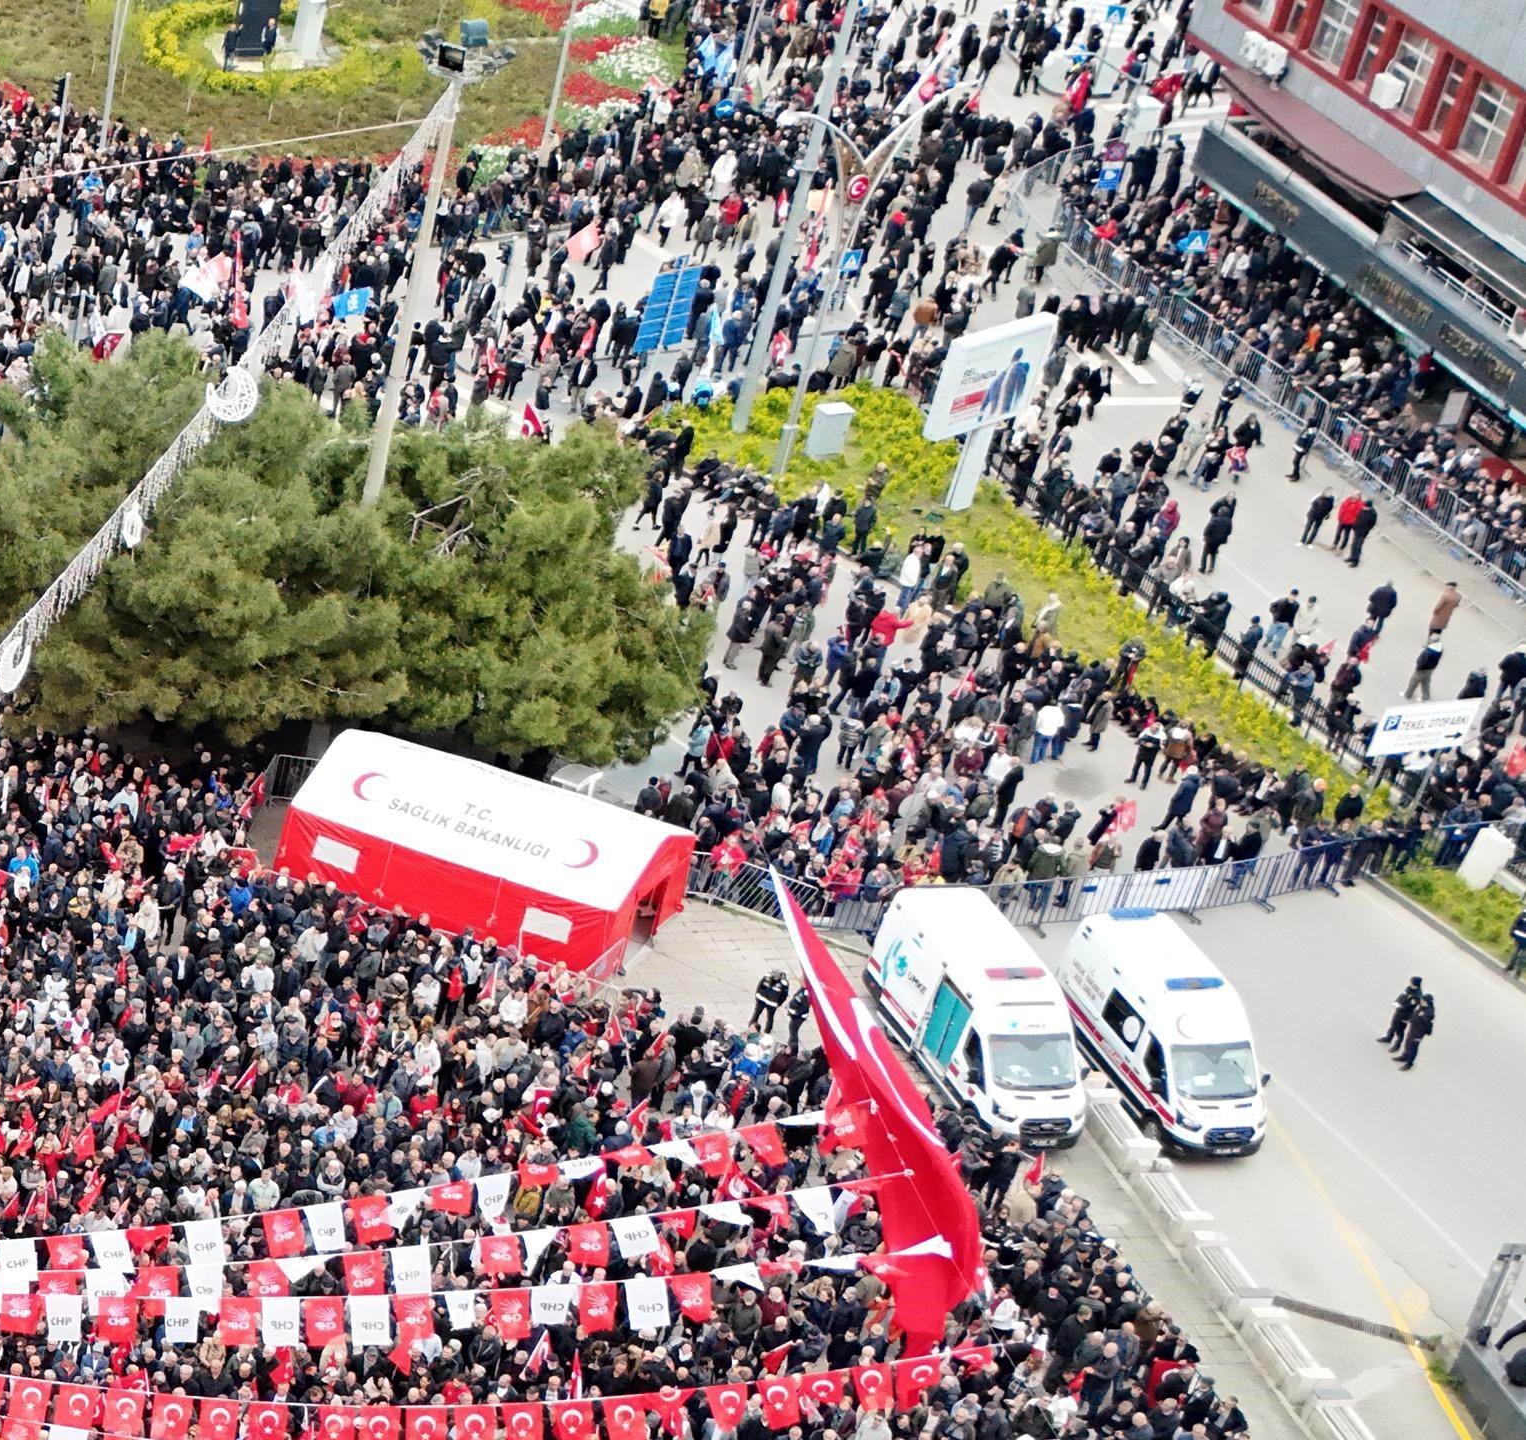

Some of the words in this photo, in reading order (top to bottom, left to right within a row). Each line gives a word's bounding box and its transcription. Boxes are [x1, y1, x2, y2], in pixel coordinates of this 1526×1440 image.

[463, 802, 493, 821] T.C.
[387, 797, 451, 829] SAĞLIK
[453, 820, 550, 861] BAKANLIĞI
[834, 1123, 856, 1136] CHP
[442, 1191, 463, 1200] CHP
[274, 1230, 296, 1242] CHP
[194, 1242, 216, 1251] CHP
[6, 1259, 29, 1268] CHP
[397, 1271, 420, 1281] CHP
[353, 1278, 375, 1288] CHP
[259, 1284, 281, 1295] CHP
[9, 1309, 31, 1318] CHP
[51, 1317, 72, 1326] CHP
[108, 1317, 129, 1326] CHP
[166, 1318, 189, 1327] CHP
